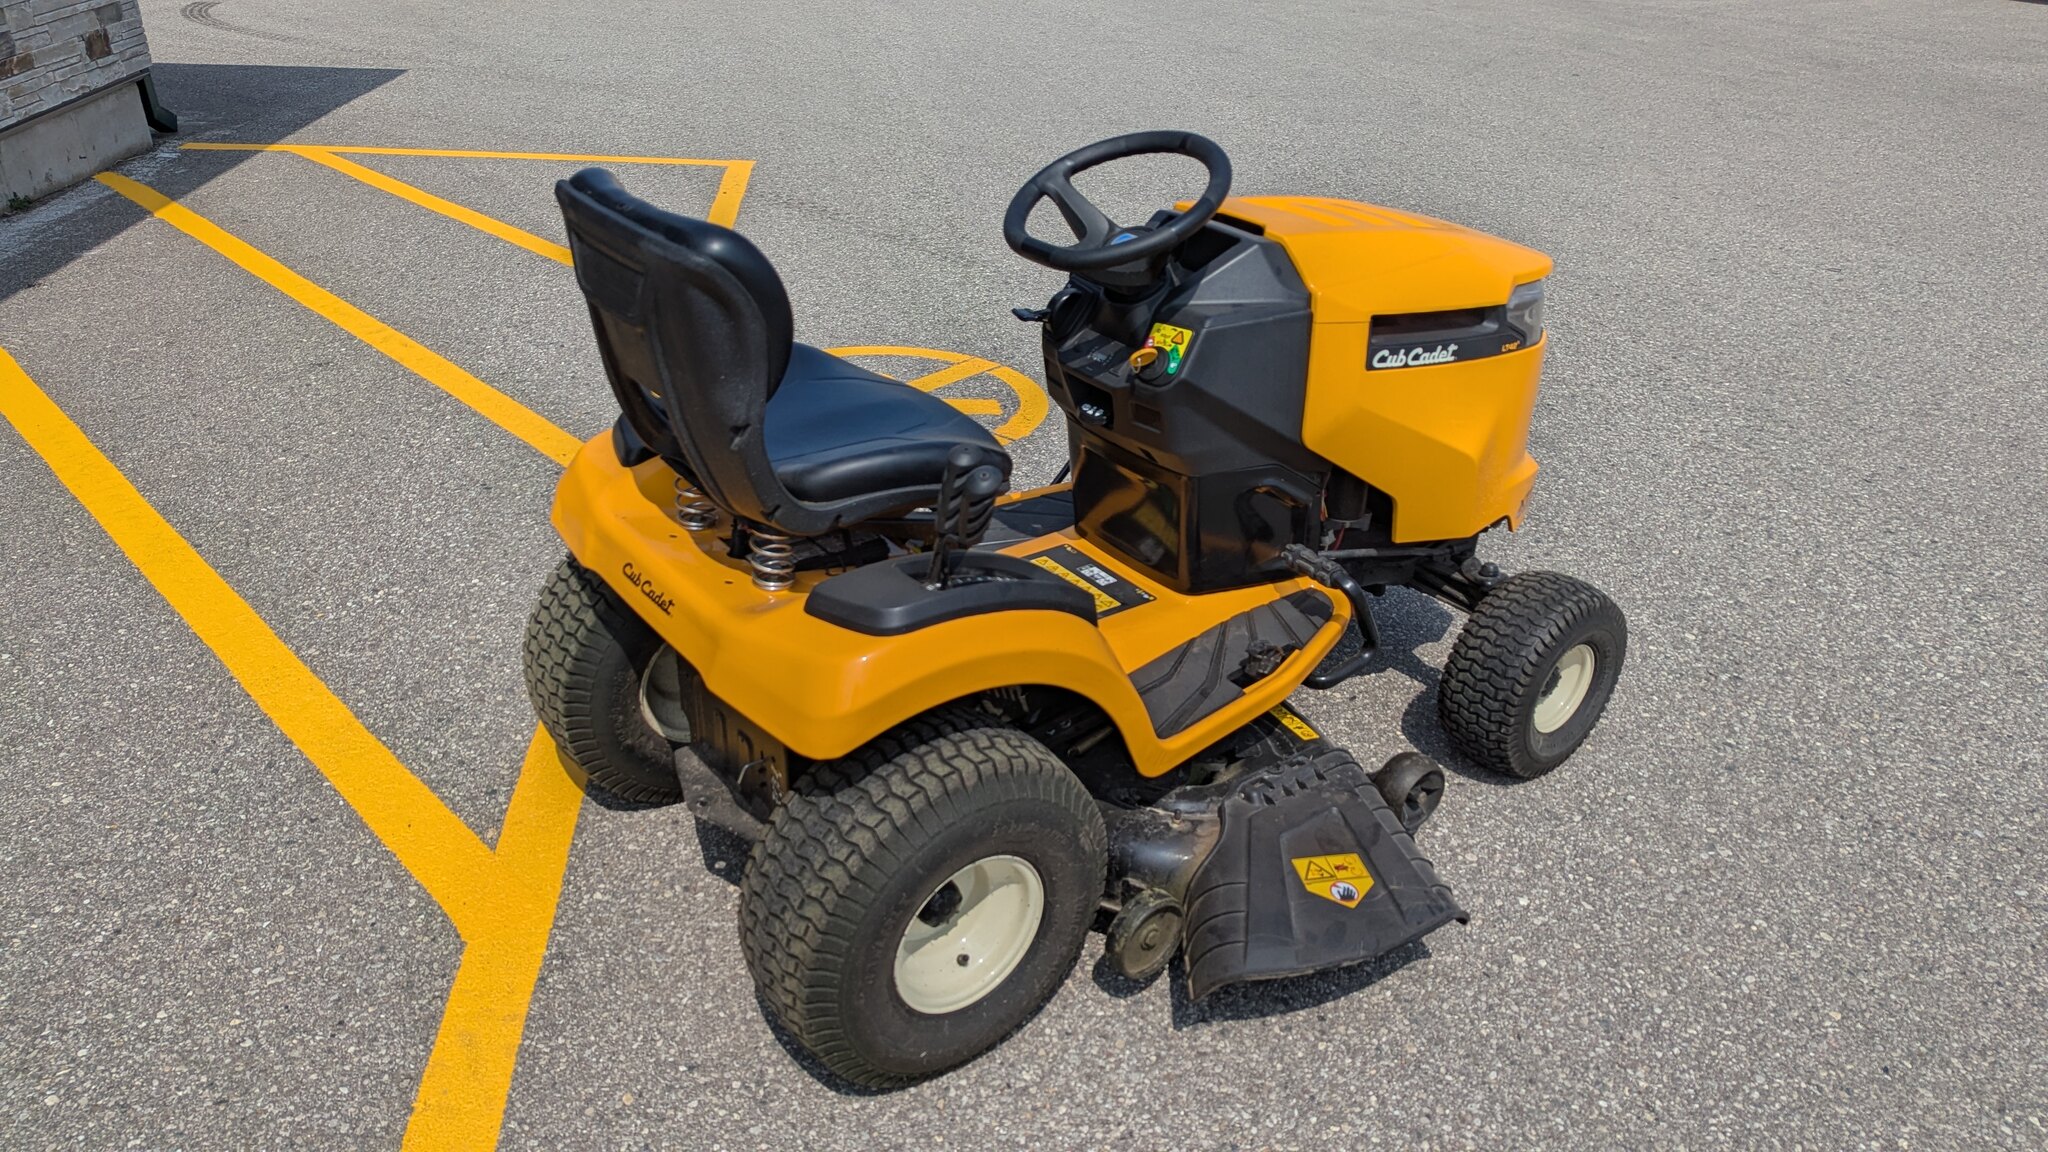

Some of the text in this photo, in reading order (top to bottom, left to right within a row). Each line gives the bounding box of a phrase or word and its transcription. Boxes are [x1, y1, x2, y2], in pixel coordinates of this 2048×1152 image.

[1372, 343, 1459, 368] Cub Cadet
[622, 562, 676, 616] Cub Cadet
